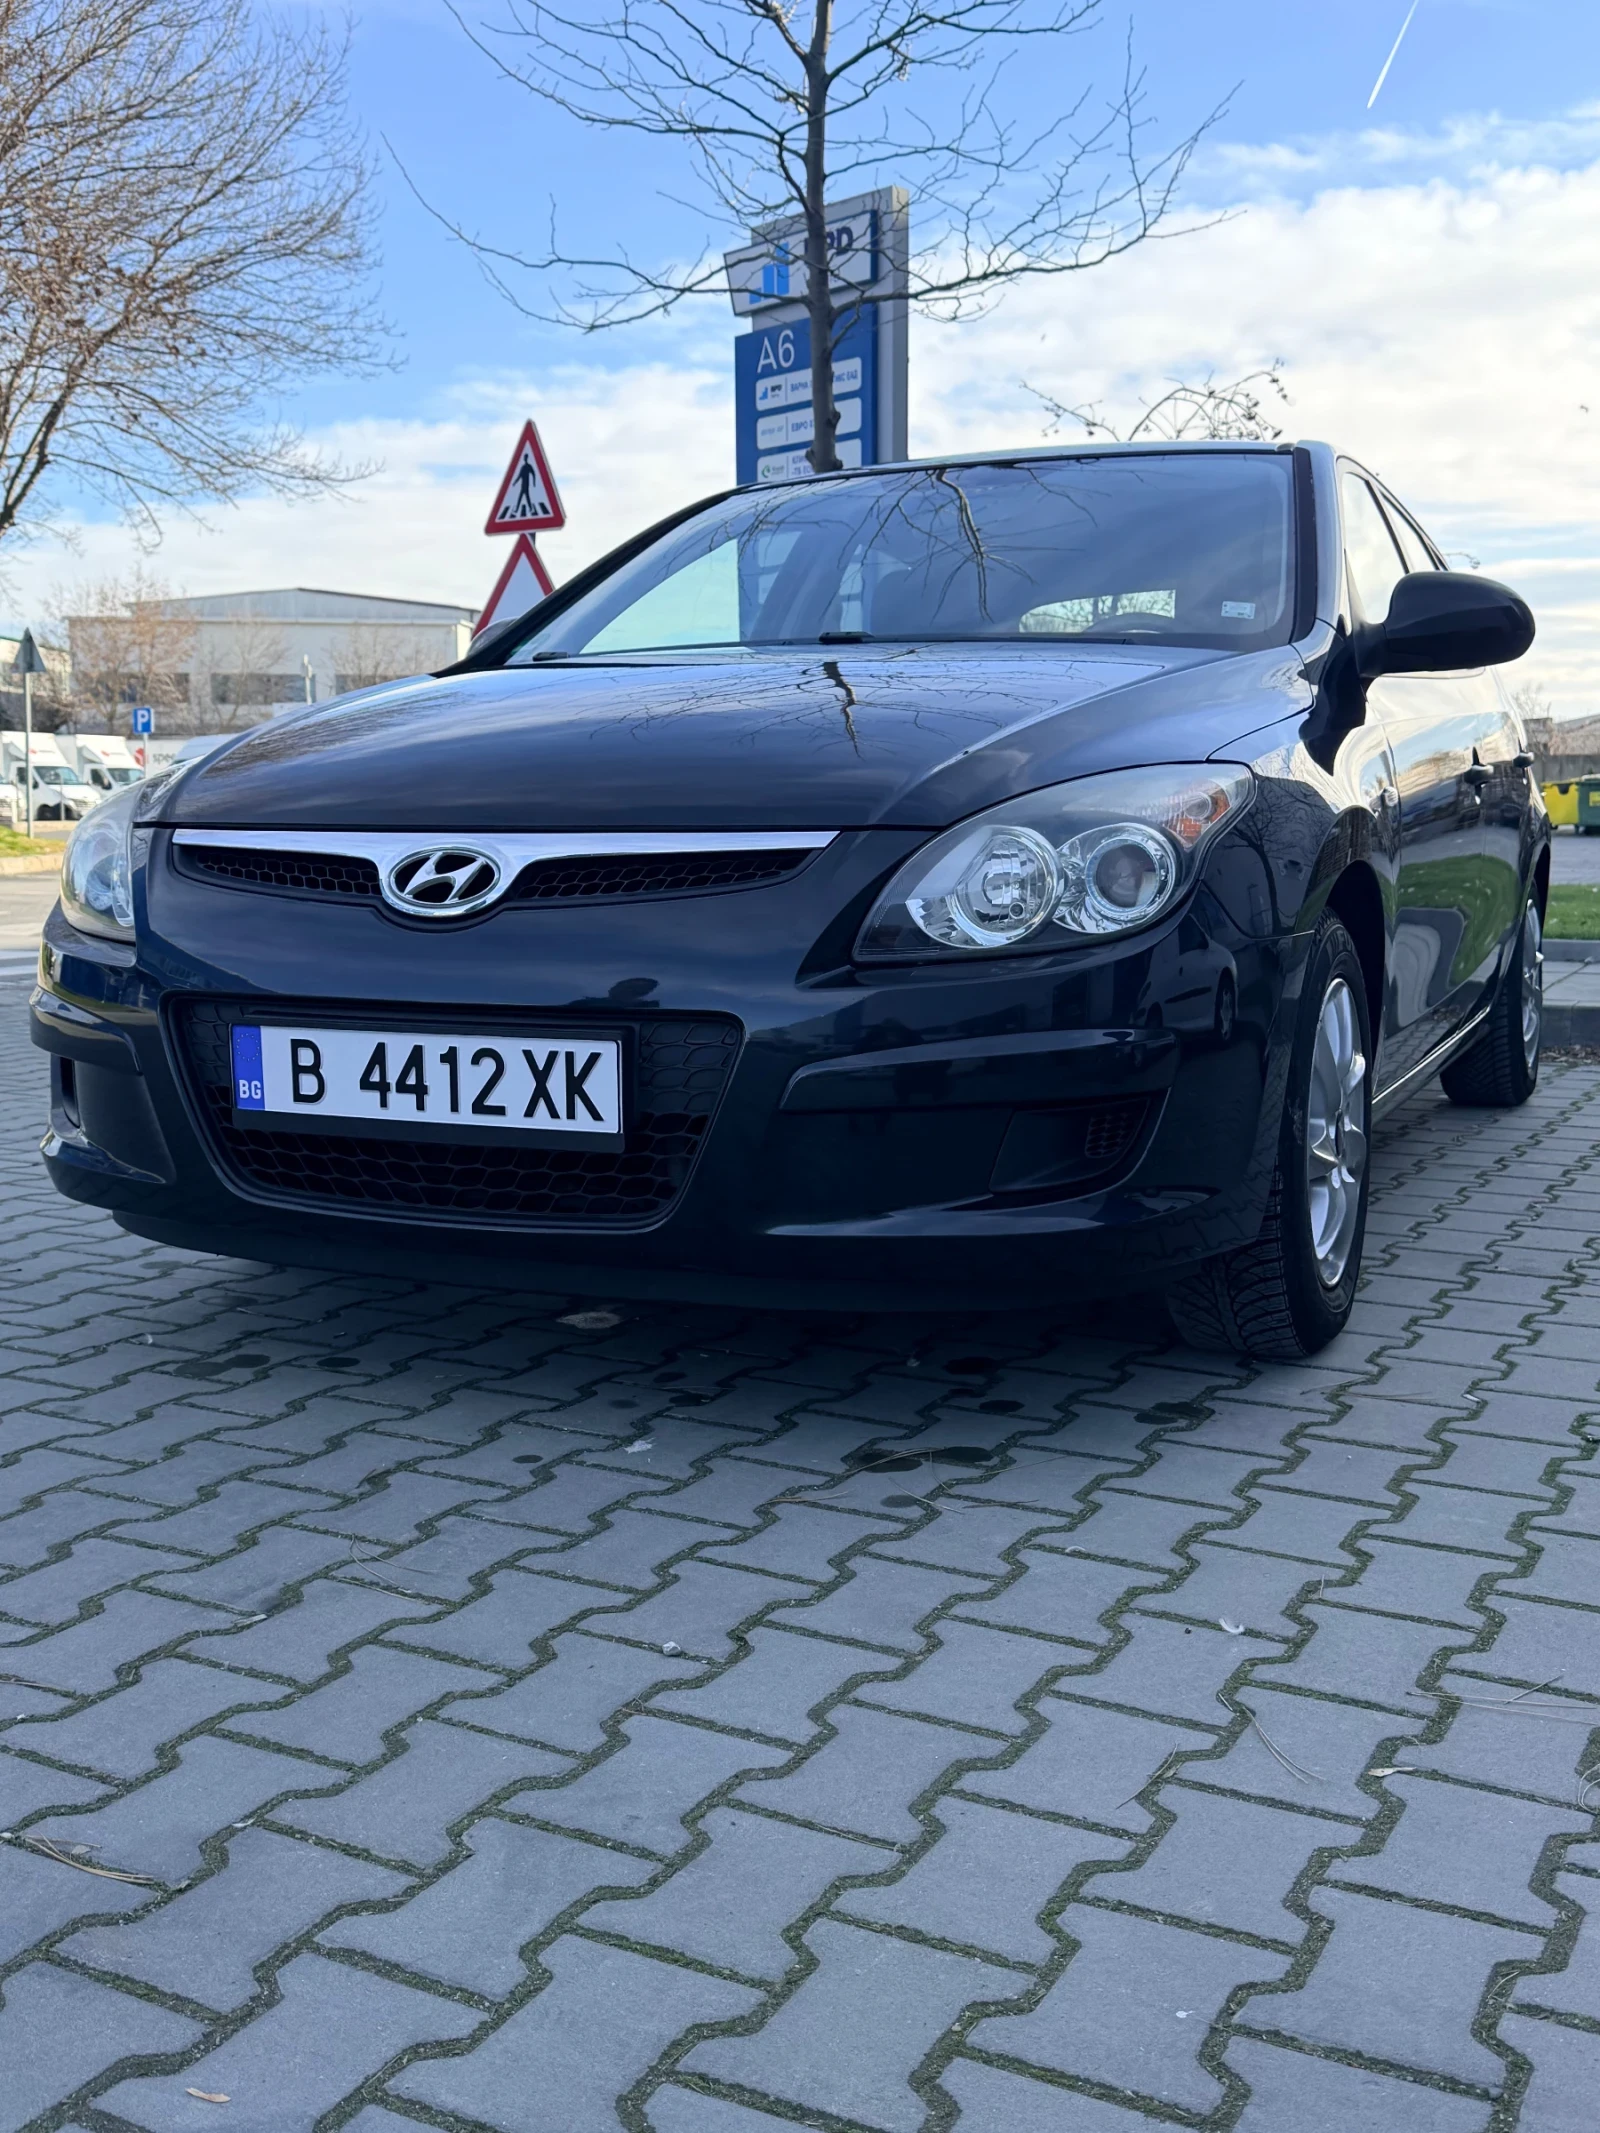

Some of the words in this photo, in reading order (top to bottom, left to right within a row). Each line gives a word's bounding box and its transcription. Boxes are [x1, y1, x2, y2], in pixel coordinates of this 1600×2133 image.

[804, 226, 853, 257] PD
[756, 329, 795, 374] A6
[136, 709, 150, 732] P
[238, 1079, 262, 1100] BG
[290, 1038, 326, 1104] B
[359, 1042, 507, 1116] 4412
[522, 1049, 604, 1122] XK
